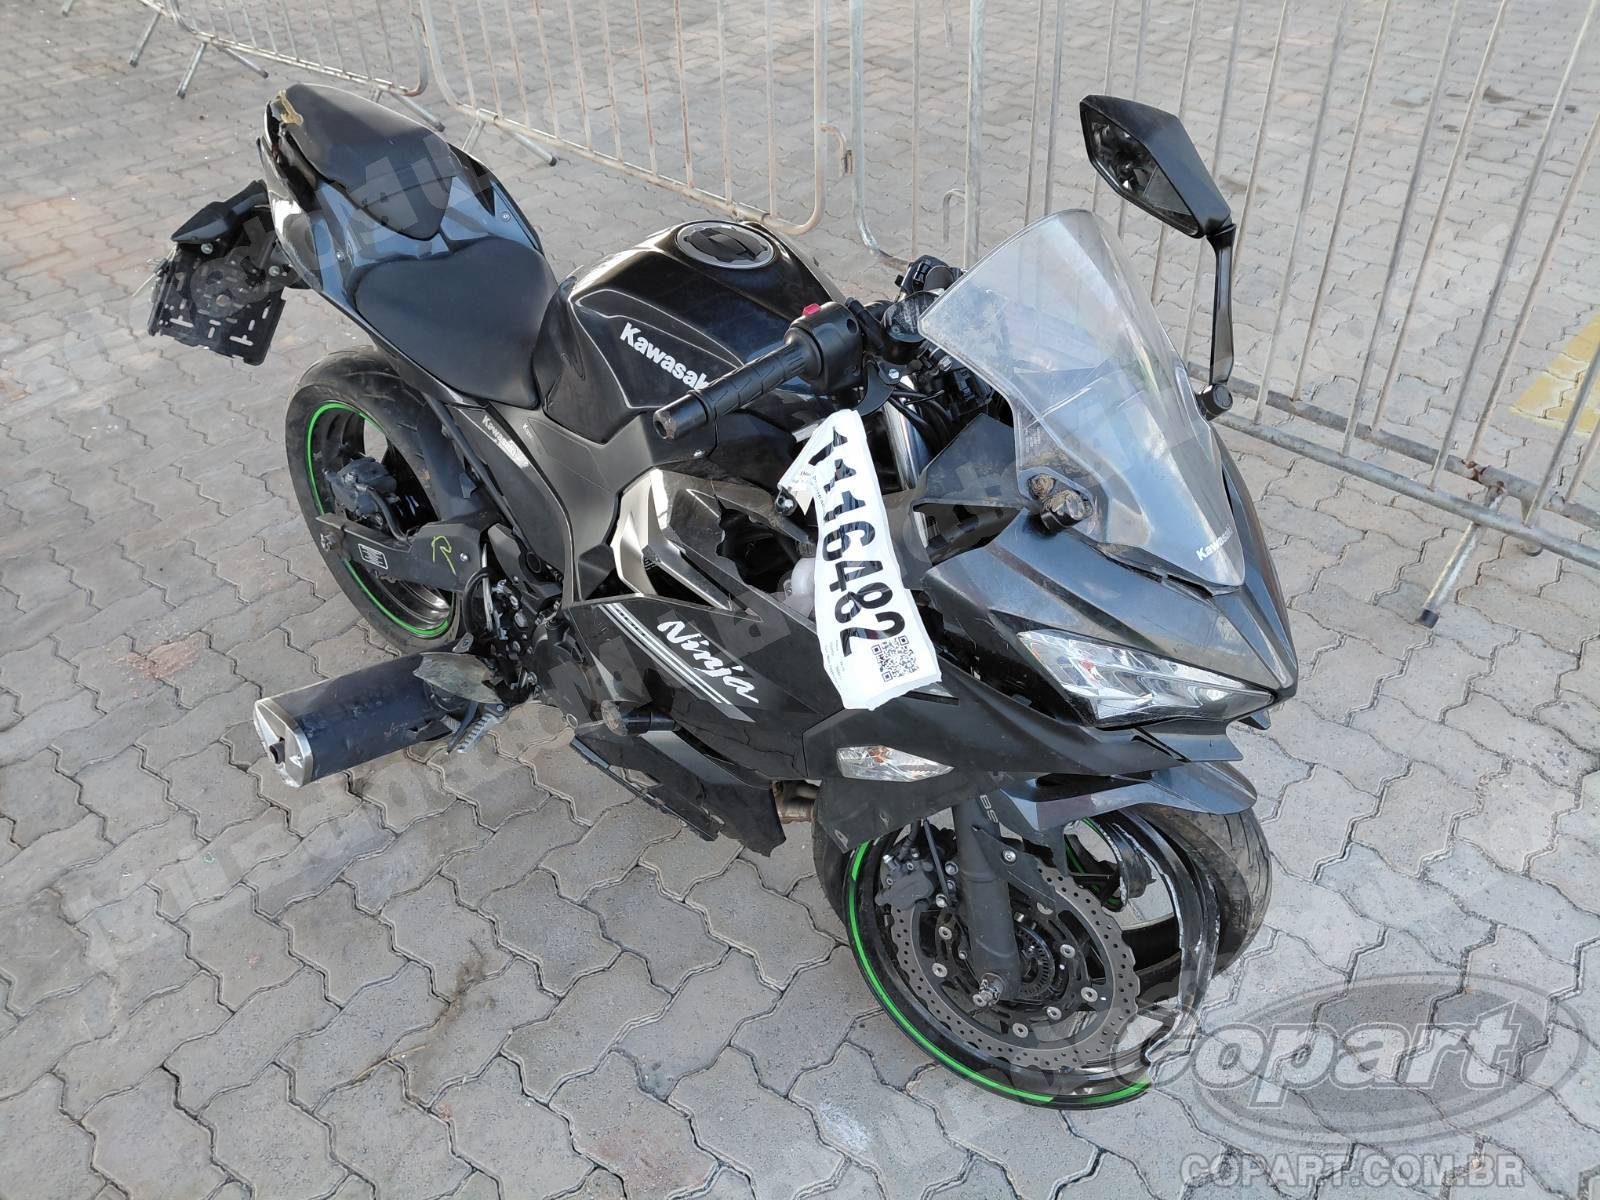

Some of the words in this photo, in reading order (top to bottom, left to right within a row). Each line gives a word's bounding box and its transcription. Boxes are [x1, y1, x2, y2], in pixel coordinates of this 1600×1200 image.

[619, 322, 711, 391] Kawasak
[808, 426, 906, 658] 1116482
[657, 620, 760, 704] Ninja
[979, 794, 999, 823] BS
